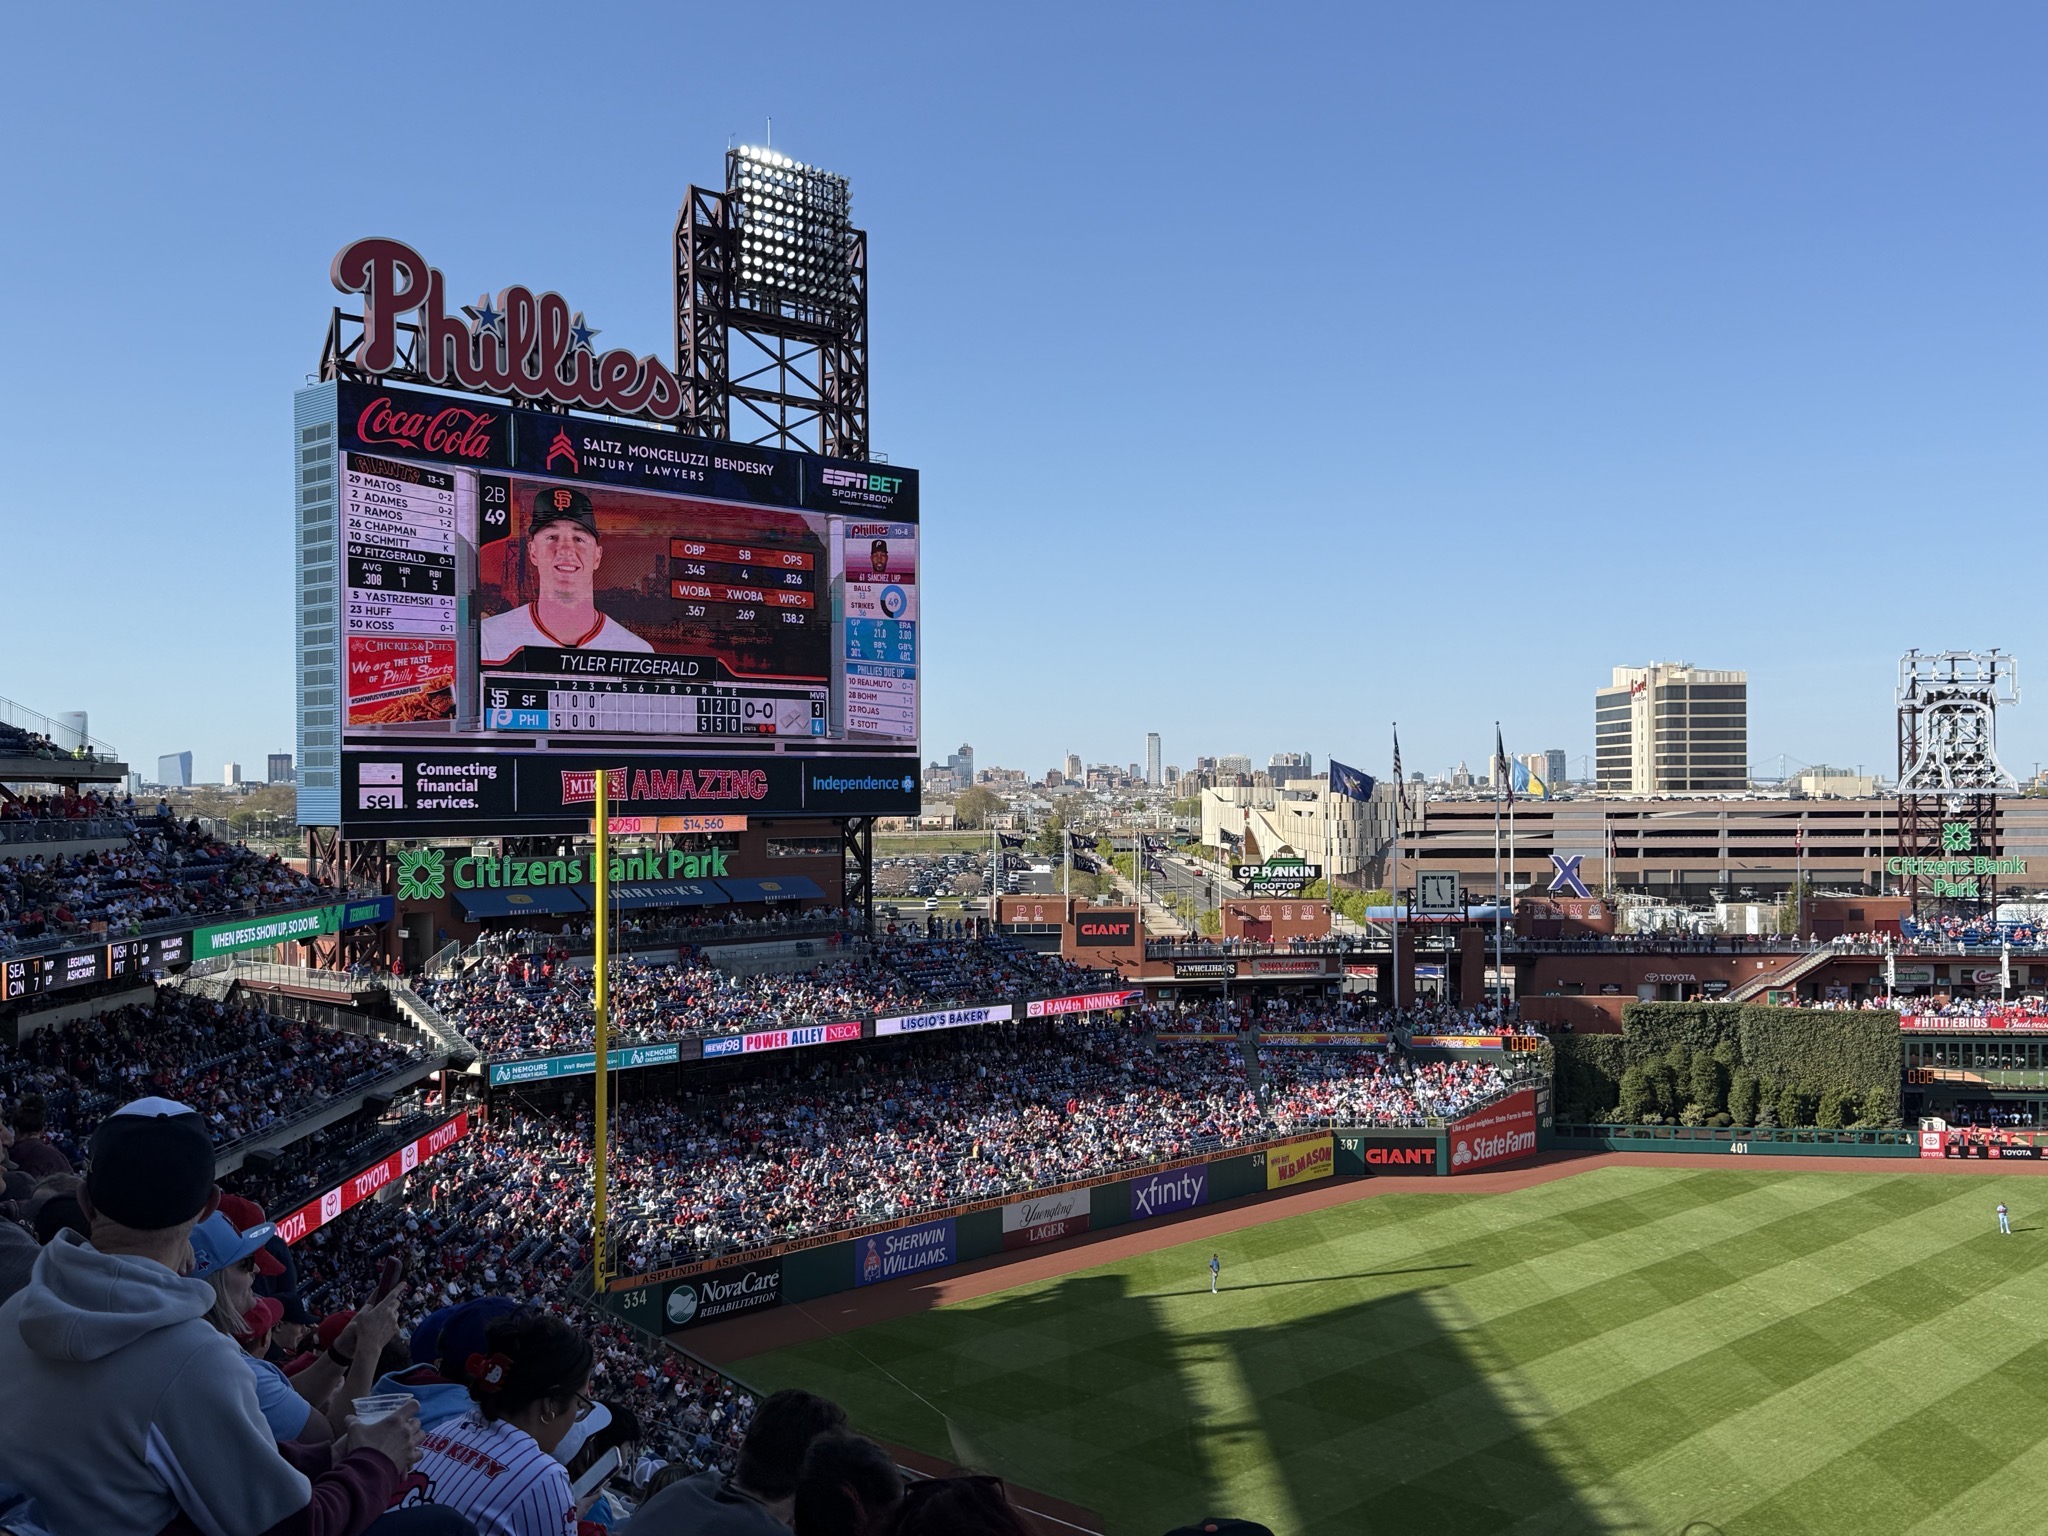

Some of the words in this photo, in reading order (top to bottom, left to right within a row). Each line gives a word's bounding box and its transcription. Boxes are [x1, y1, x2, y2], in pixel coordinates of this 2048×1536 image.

[330, 236, 683, 419] Phillies
[357, 397, 498, 459] Coca-Cola
[583, 437, 622, 455] SALTZ
[628, 444, 709, 467] MONGELUZZI
[714, 458, 774, 476] BENDESKY
[355, 456, 421, 484] GIANTS
[583, 457, 634, 472] INJURY
[645, 466, 705, 481] LAWYERS
[364, 478, 402, 493] MATOS
[484, 486, 505, 503] 2B
[364, 493, 408, 508] ADAMES
[832, 489, 894, 504] SPORTSBOOK
[364, 506, 403, 521] RAMOS
[484, 509, 506, 525] 49
[364, 522, 417, 536] CHAPMAN
[364, 534, 410, 548] SCHMITT
[349, 545, 361, 554] 49
[364, 548, 426, 563] FITZGERALD
[684, 544, 705, 555] OBP
[739, 550, 751, 560] SB
[783, 554, 802, 566] OPS
[362, 563, 382, 572] AVG
[399, 567, 411, 575] HR
[429, 570, 442, 578] RBI
[685, 565, 705, 576] .345
[366, 593, 433, 606] YASTRZEMSKI
[679, 585, 711, 598] WOBA
[726, 589, 764, 602] XWOBA
[779, 594, 807, 605] WRC+
[366, 607, 392, 616] HUFF
[366, 620, 394, 630] KOSS
[352, 661, 371, 674] We
[373, 661, 391, 670] are
[393, 658, 408, 667] THE
[410, 655, 433, 665] TASTE
[383, 669, 413, 684] Philly
[415, 664, 453, 678] Sports
[560, 655, 606, 672] TYLER
[610, 658, 700, 677] FITZGERALD
[857, 665, 882, 676] PHILLIES
[857, 679, 893, 689] REALMUTO
[522, 695, 537, 706] SF
[745, 702, 773, 719] 0-0
[519, 715, 539, 726] PHI
[417, 763, 497, 779] Connecting
[417, 778, 478, 792] financial
[570, 778, 620, 794] MIK'S
[631, 769, 768, 800] AMAZING
[812, 776, 899, 793] Independence
[417, 797, 479, 809] services.
[683, 818, 724, 831] $14,560
[453, 855, 582, 889] Citizens
[668, 846, 729, 879] Park
[1239, 866, 1259, 877] CP
[1262, 866, 1315, 877] RANKIN
[1887, 855, 1969, 876] Citizens
[1974, 855, 2026, 875] Bank
[1253, 882, 1301, 890] ROOFTOP
[1548, 855, 1593, 898] X
[608, 887, 655, 900] ARRY
[655, 887, 676, 896] THE
[677, 885, 703, 897] K'S
[1934, 878, 1980, 897] Park
[1260, 905, 1271, 916] 14
[1282, 905, 1292, 916] 15
[1301, 905, 1314, 916] 20
[211, 932, 235, 949] WHEN
[235, 928, 256, 945] PESTS
[256, 925, 276, 941] SHOW
[278, 924, 288, 937] UP,
[289, 922, 297, 933] SO
[299, 919, 308, 932] DO
[307, 916, 320, 930] WE.
[1081, 924, 1129, 935] GIANT
[113, 944, 127, 959] WSH
[161, 937, 183, 950] WILLIAMS
[9, 963, 25, 979] SEA
[67, 955, 95, 968] LEGUMINA
[114, 961, 125, 974] PIT
[162, 950, 181, 961] HEANEY
[9, 981, 25, 996] CIN
[67, 967, 95, 981] ASHCRAFT
[1047, 1000, 1081, 1014] RAV4th
[1084, 995, 1121, 1010] INNING
[901, 1014, 946, 1030] LISCIO'S
[950, 1009, 990, 1024] BAKERY
[1914, 1017, 1987, 1028] #HITTHEBUDS
[746, 1032, 788, 1050] POWER
[792, 1028, 823, 1046] ALLEY
[829, 1026, 860, 1039] NECA
[1266, 1034, 1298, 1045] Surfside
[1328, 1034, 1360, 1045] Surfside
[645, 1047, 676, 1058] NEMOURS
[512, 1063, 548, 1074] NEMOURS
[1452, 1124, 1461, 1132] Like
[1466, 1121, 1476, 1131] good
[1477, 1117, 1495, 1128] neighbor,
[1495, 1114, 1506, 1122] State
[1507, 1112, 1517, 1120] Farm
[428, 1121, 457, 1153] TOYOTA
[1295, 1132, 1327, 1144] ASPLUNDH
[1340, 1139, 1358, 1151] 387
[1366, 1148, 1435, 1164] GIANT
[1730, 1143, 1748, 1154] 401
[1253, 1154, 1264, 1167] 374
[355, 1162, 390, 1198] TOYOTA
[1136, 1172, 1203, 1215] xfinity
[1019, 1197, 1075, 1228] Yuengling
[275, 1212, 306, 1243] YOTA
[1029, 1223, 1066, 1242] LAGER
[884, 1227, 946, 1254] SHERWIN
[884, 1248, 947, 1276] WILLIAMS
[642, 1264, 703, 1285] ASPLUNDH
[700, 1271, 779, 1304] NovaCare
[624, 1290, 647, 1309] 334
[700, 1291, 777, 1318] REHABILITATION
[444, 1441, 510, 1479] KITTY
